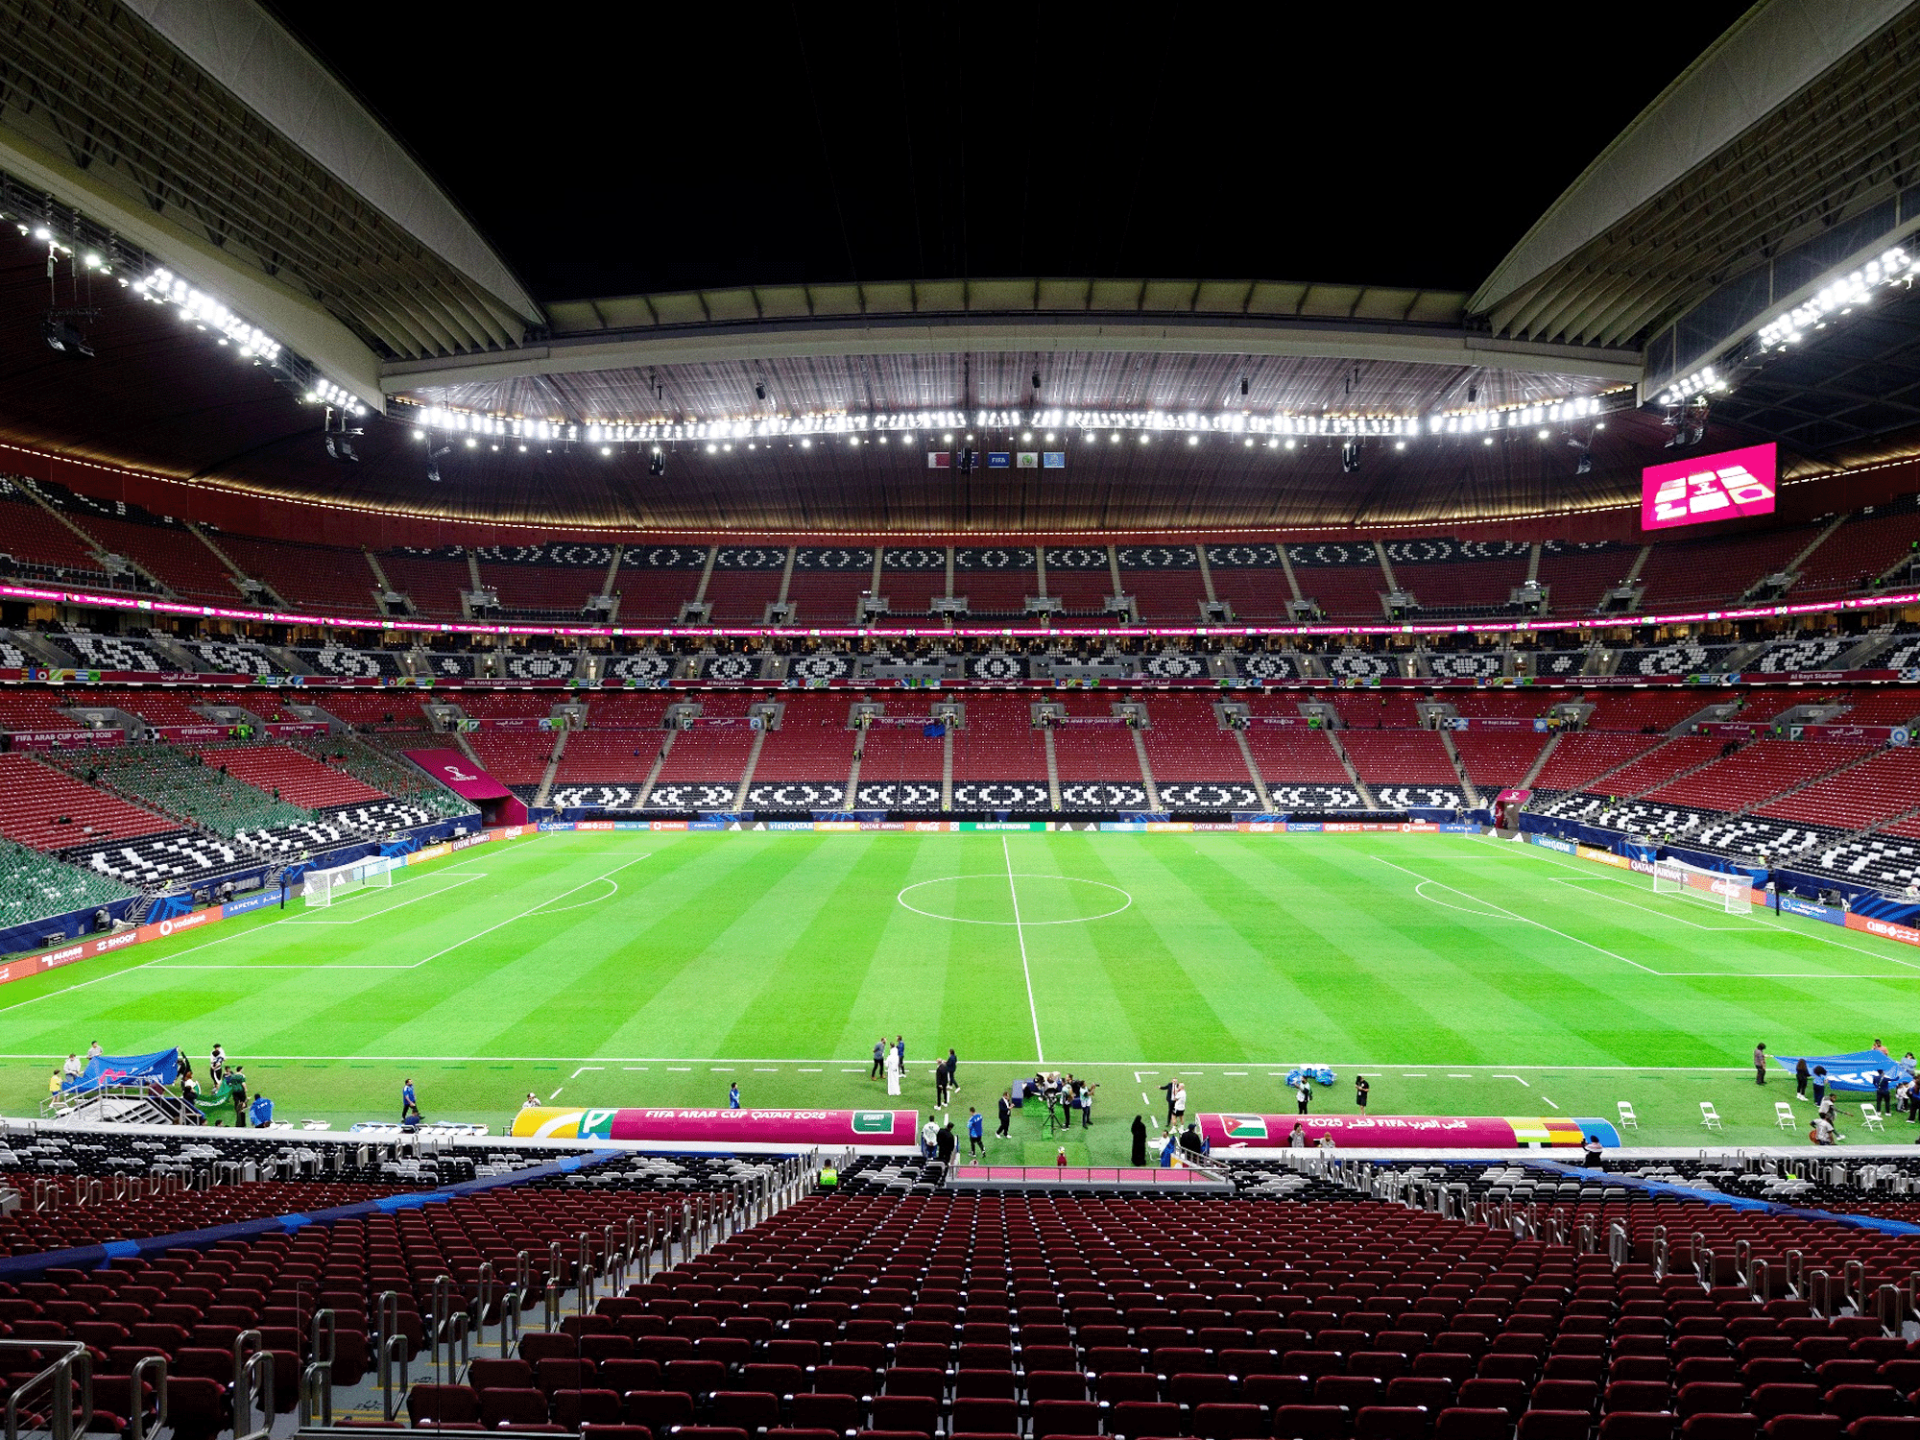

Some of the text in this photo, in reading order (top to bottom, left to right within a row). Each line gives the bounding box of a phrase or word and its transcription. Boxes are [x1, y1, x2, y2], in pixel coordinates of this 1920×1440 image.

[15, 734, 32, 742] FIFA
[173, 914, 206, 929] vodafone
[107, 932, 136, 948] SHOOF
[645, 1110, 675, 1118] FIFA
[678, 1110, 718, 1118] ARAB
[720, 1110, 748, 1119] CUP
[751, 1111, 792, 1121] QATAR
[1346, 1118, 1376, 1130] قطر
[1375, 1119, 1408, 1128] FIFA
[1407, 1119, 1441, 1131] العرب
